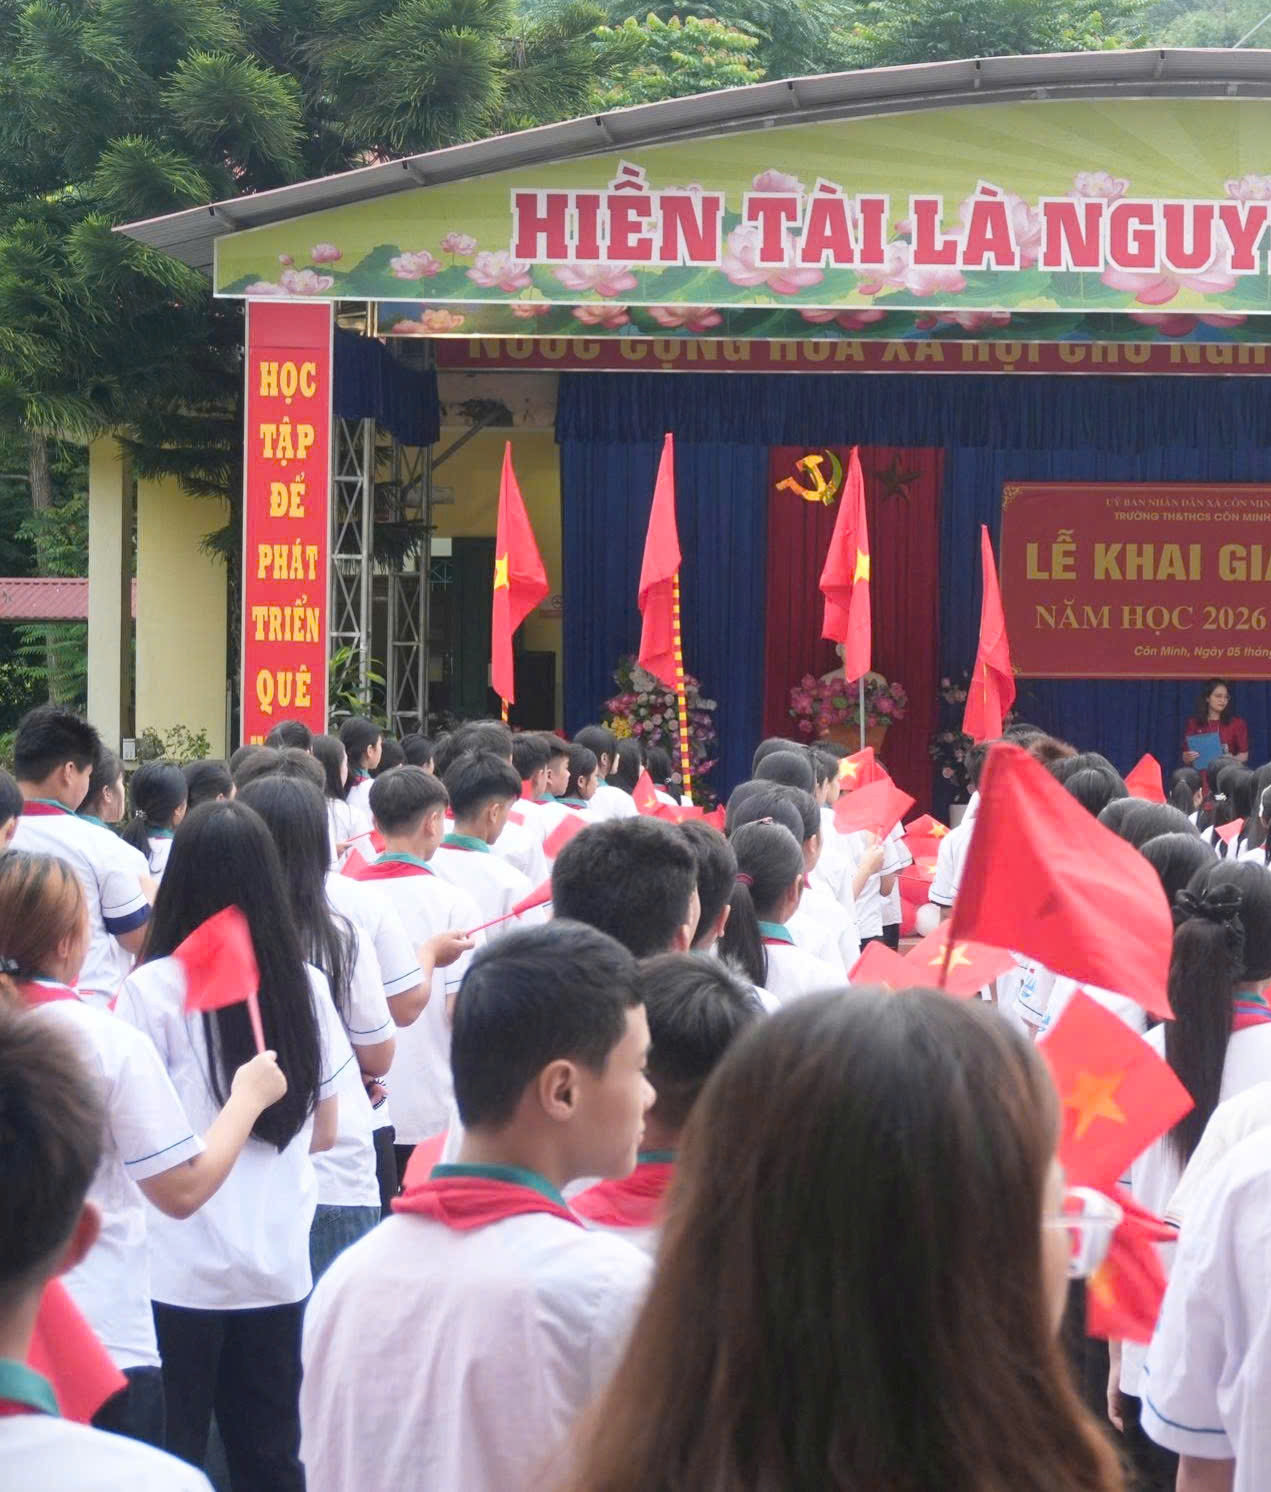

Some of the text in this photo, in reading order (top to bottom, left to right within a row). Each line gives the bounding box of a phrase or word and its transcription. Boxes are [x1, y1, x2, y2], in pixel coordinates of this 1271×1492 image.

[512, 161, 723, 264] HIỀN
[744, 177, 888, 267] TÀI
[909, 180, 1020, 270] LÀ
[259, 361, 317, 405] HỌC
[259, 416, 315, 467] TẬP
[269, 472, 306, 518] ĐỂ
[1114, 509, 1271, 522] TRƯỜNG TH&THCS CÔN MINH
[257, 538, 319, 580] PHÁT
[1025, 529, 1078, 581] LỄ
[1093, 543, 1201, 581] KHAI
[251, 594, 320, 642] TRIỂN
[1034, 595, 1111, 630] NĂM
[1120, 605, 1194, 636] HỌC
[1202, 605, 1267, 631] 2026
[1160, 646, 1191, 658] Minh,
[1194, 646, 1224, 659] Ngày
[1226, 647, 1241, 657] 05
[256, 665, 312, 715] QUÊ
